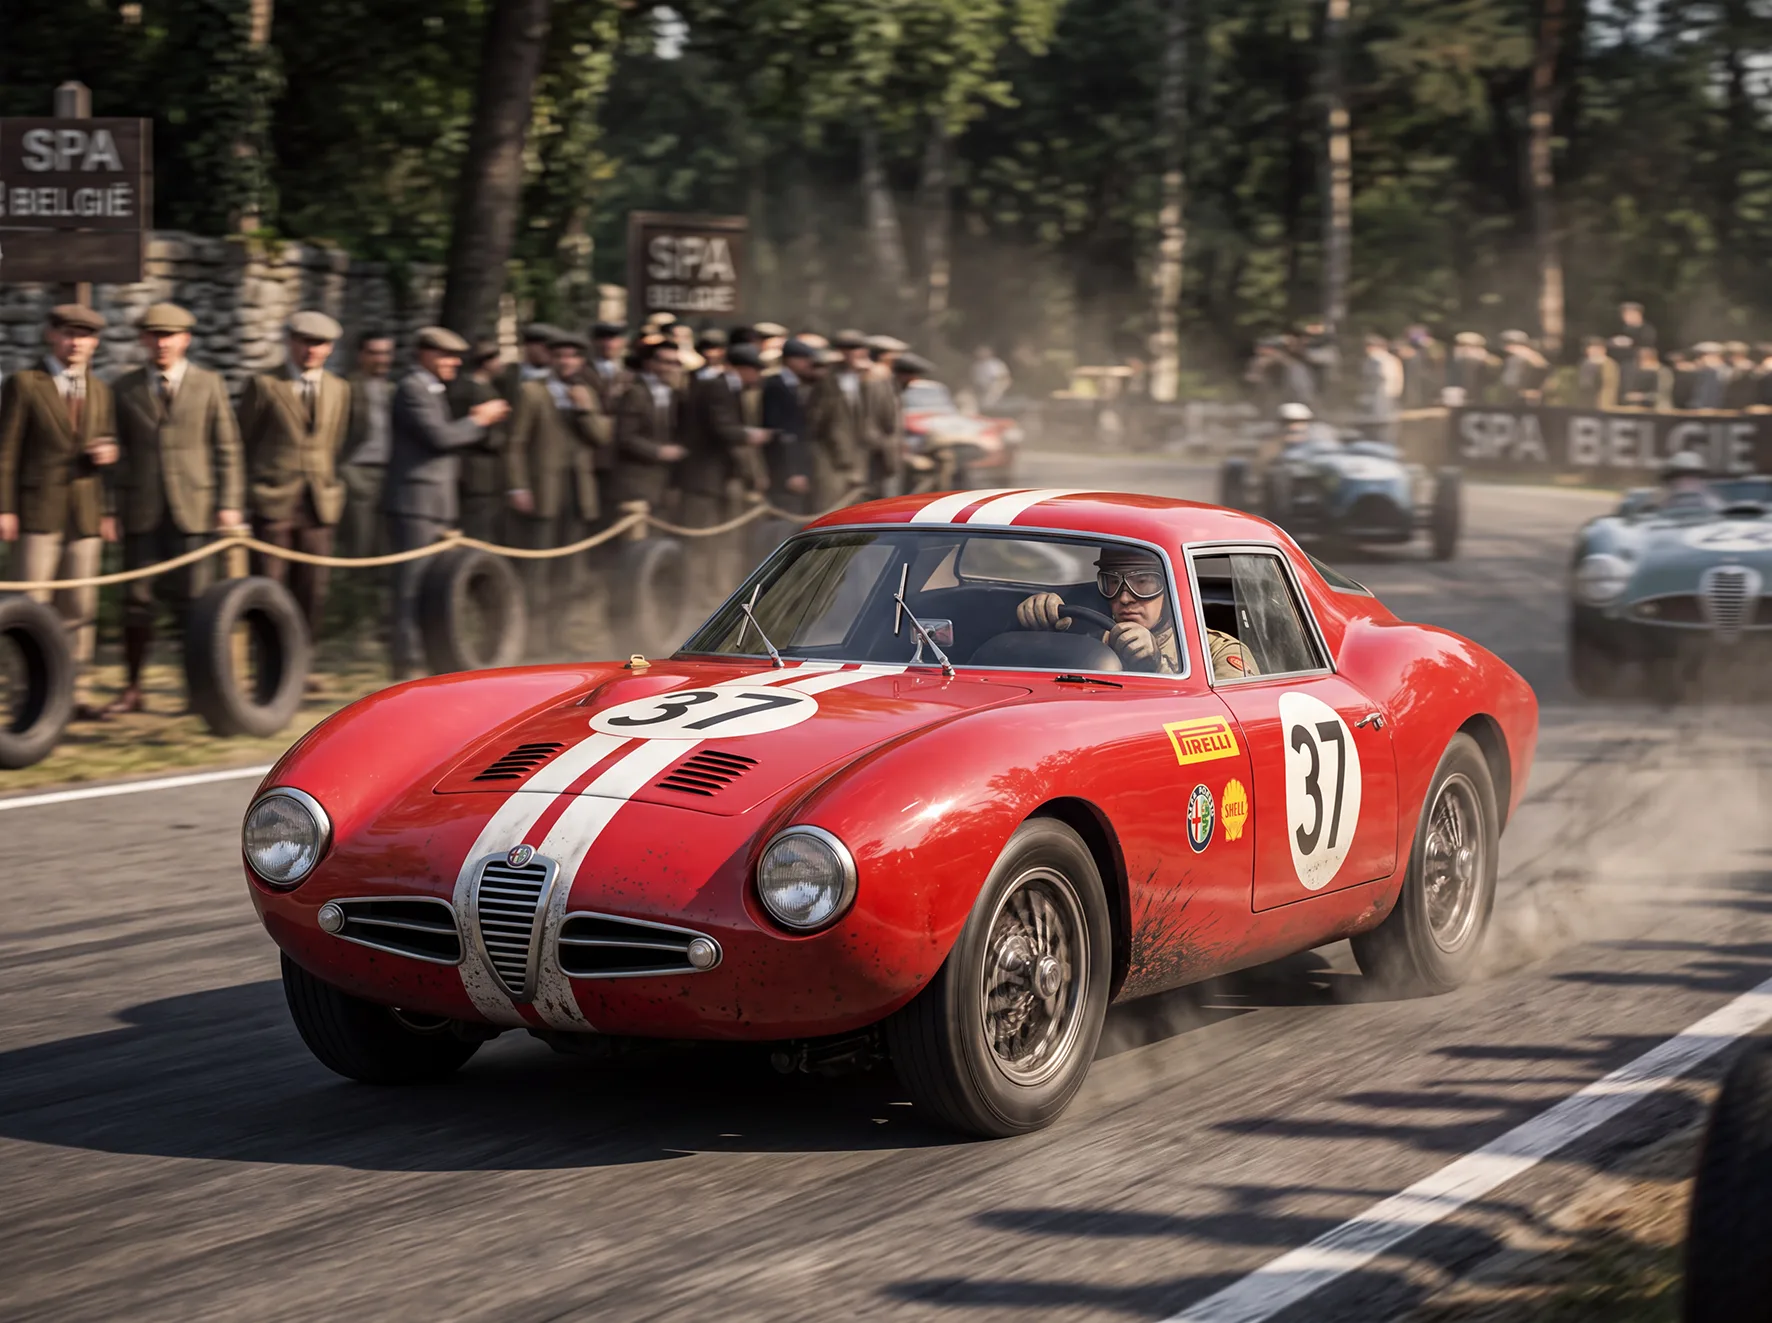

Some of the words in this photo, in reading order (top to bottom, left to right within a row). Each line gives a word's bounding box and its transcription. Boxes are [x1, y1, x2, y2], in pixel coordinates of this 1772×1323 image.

[21, 128, 124, 172] SPA
[647, 235, 736, 281] SPA
[1459, 411, 1547, 462] SPA
[607, 691, 804, 730] 37
[1172, 724, 1232, 756] PIRELLI
[1225, 801, 1245, 818] SHELL
[1291, 720, 1346, 855] 37
